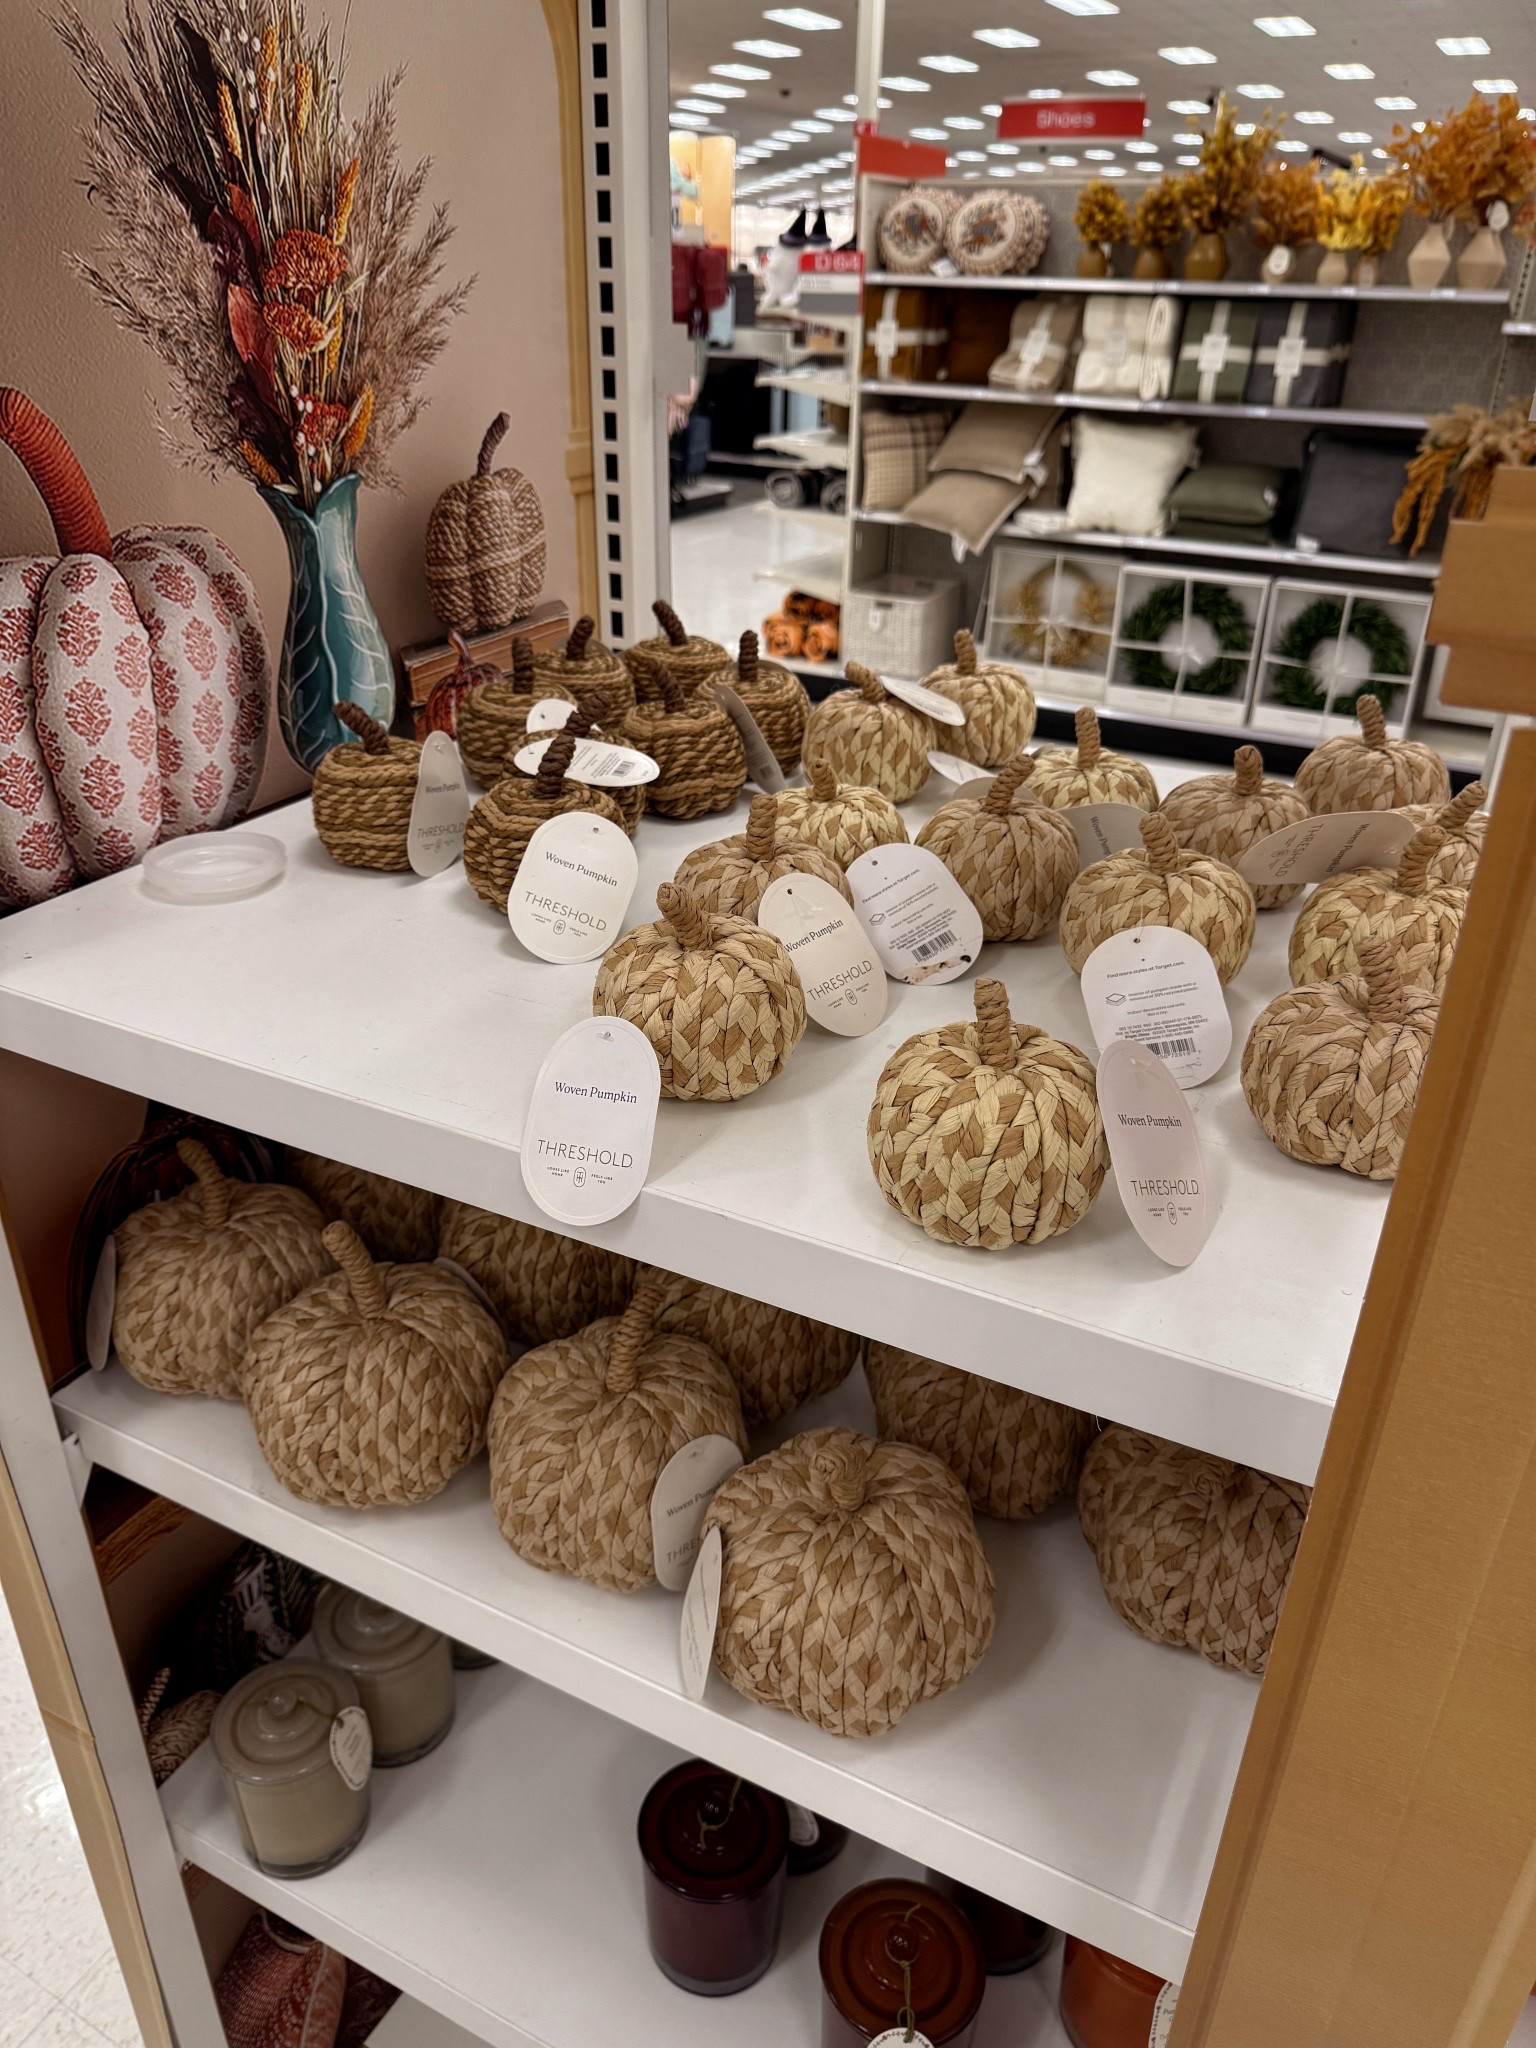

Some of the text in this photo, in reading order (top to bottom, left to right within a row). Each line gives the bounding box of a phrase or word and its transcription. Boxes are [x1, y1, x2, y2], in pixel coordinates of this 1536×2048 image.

[1036, 109, 1096, 129] Shoes
[1274, 823, 1324, 877] THRESHOLD
[545, 851, 618, 887] Woven Pumpkin
[525, 891, 607, 931] THRESHOLD
[784, 920, 844, 953] Woven Pumpkin
[806, 960, 872, 1001] THRESHOLD
[555, 1081, 637, 1104] Woven Pumpkin
[1117, 1114, 1182, 1129] Woven Pumpkin
[538, 1139, 633, 1168] THRESHOLD
[1130, 1180, 1199, 1196] THRESHOLD
[666, 1499, 694, 1517] Woven
